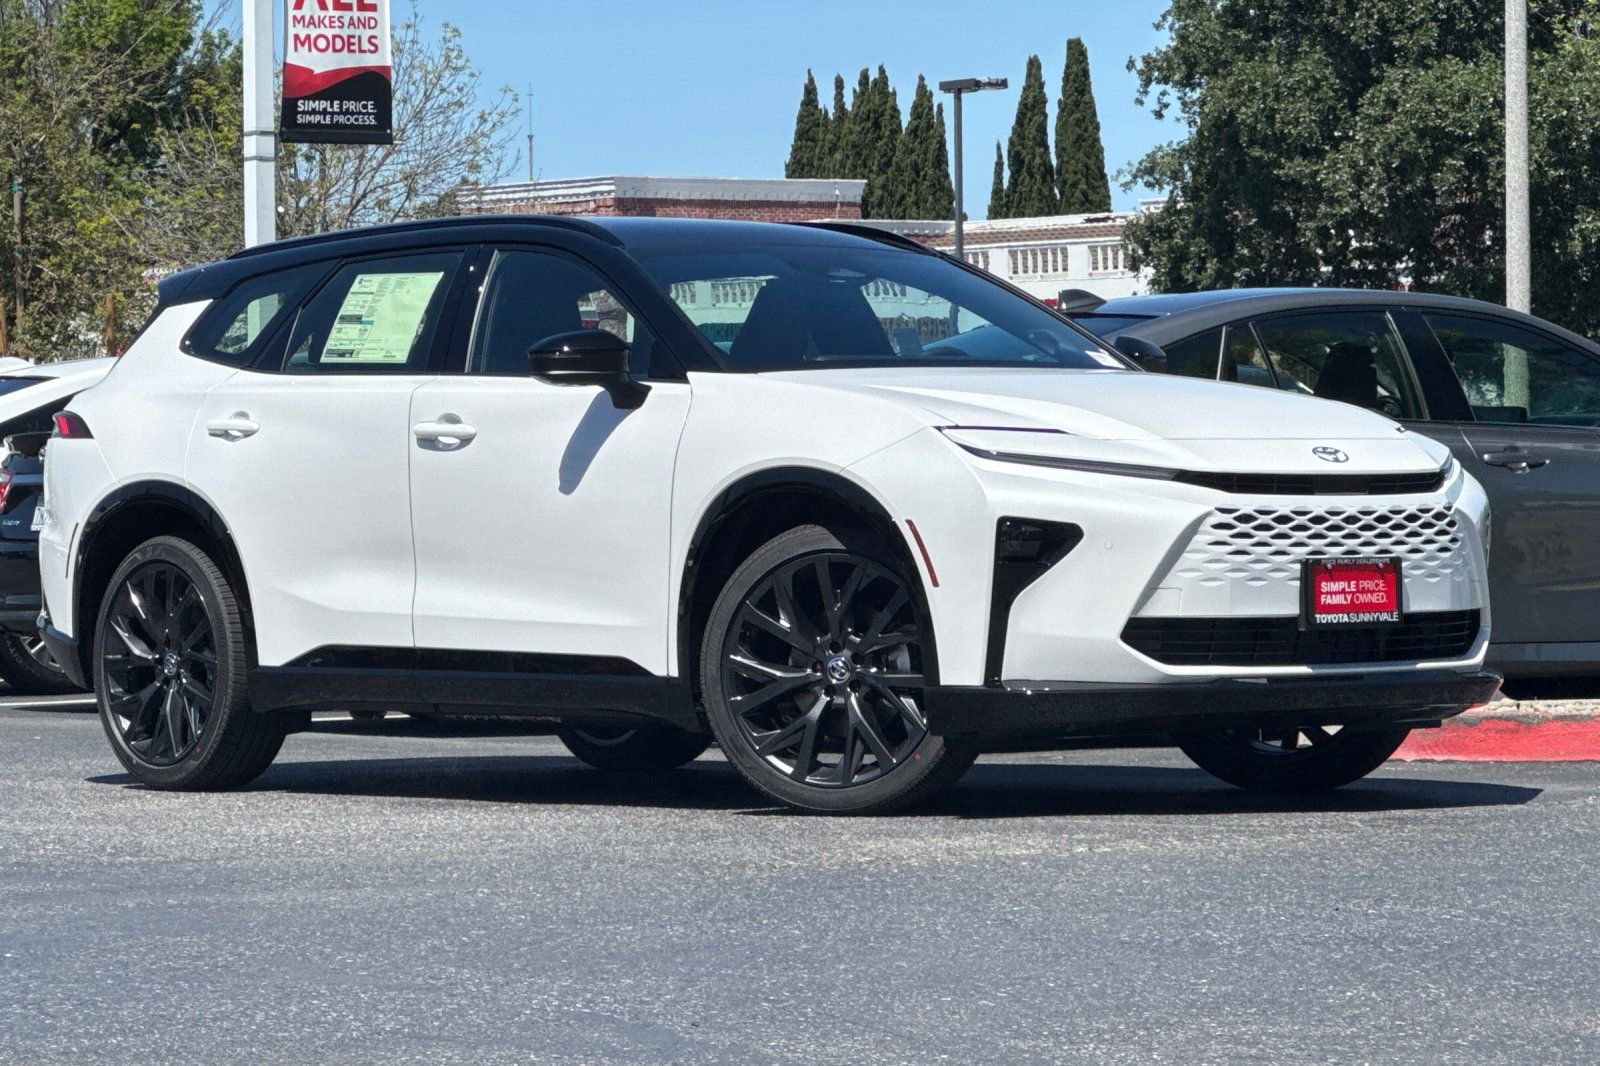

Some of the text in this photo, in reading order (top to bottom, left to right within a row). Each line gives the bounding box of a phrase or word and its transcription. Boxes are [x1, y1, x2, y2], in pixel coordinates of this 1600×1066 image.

[292, 15, 378, 30] MAKES AND
[293, 33, 379, 54] MODELS
[297, 100, 377, 113] SIMPLE PRICE.
[296, 114, 378, 125] SIMPLE PROCESS.
[1321, 581, 1357, 593] SIMPLE
[1321, 593, 1352, 605] FAMILY
